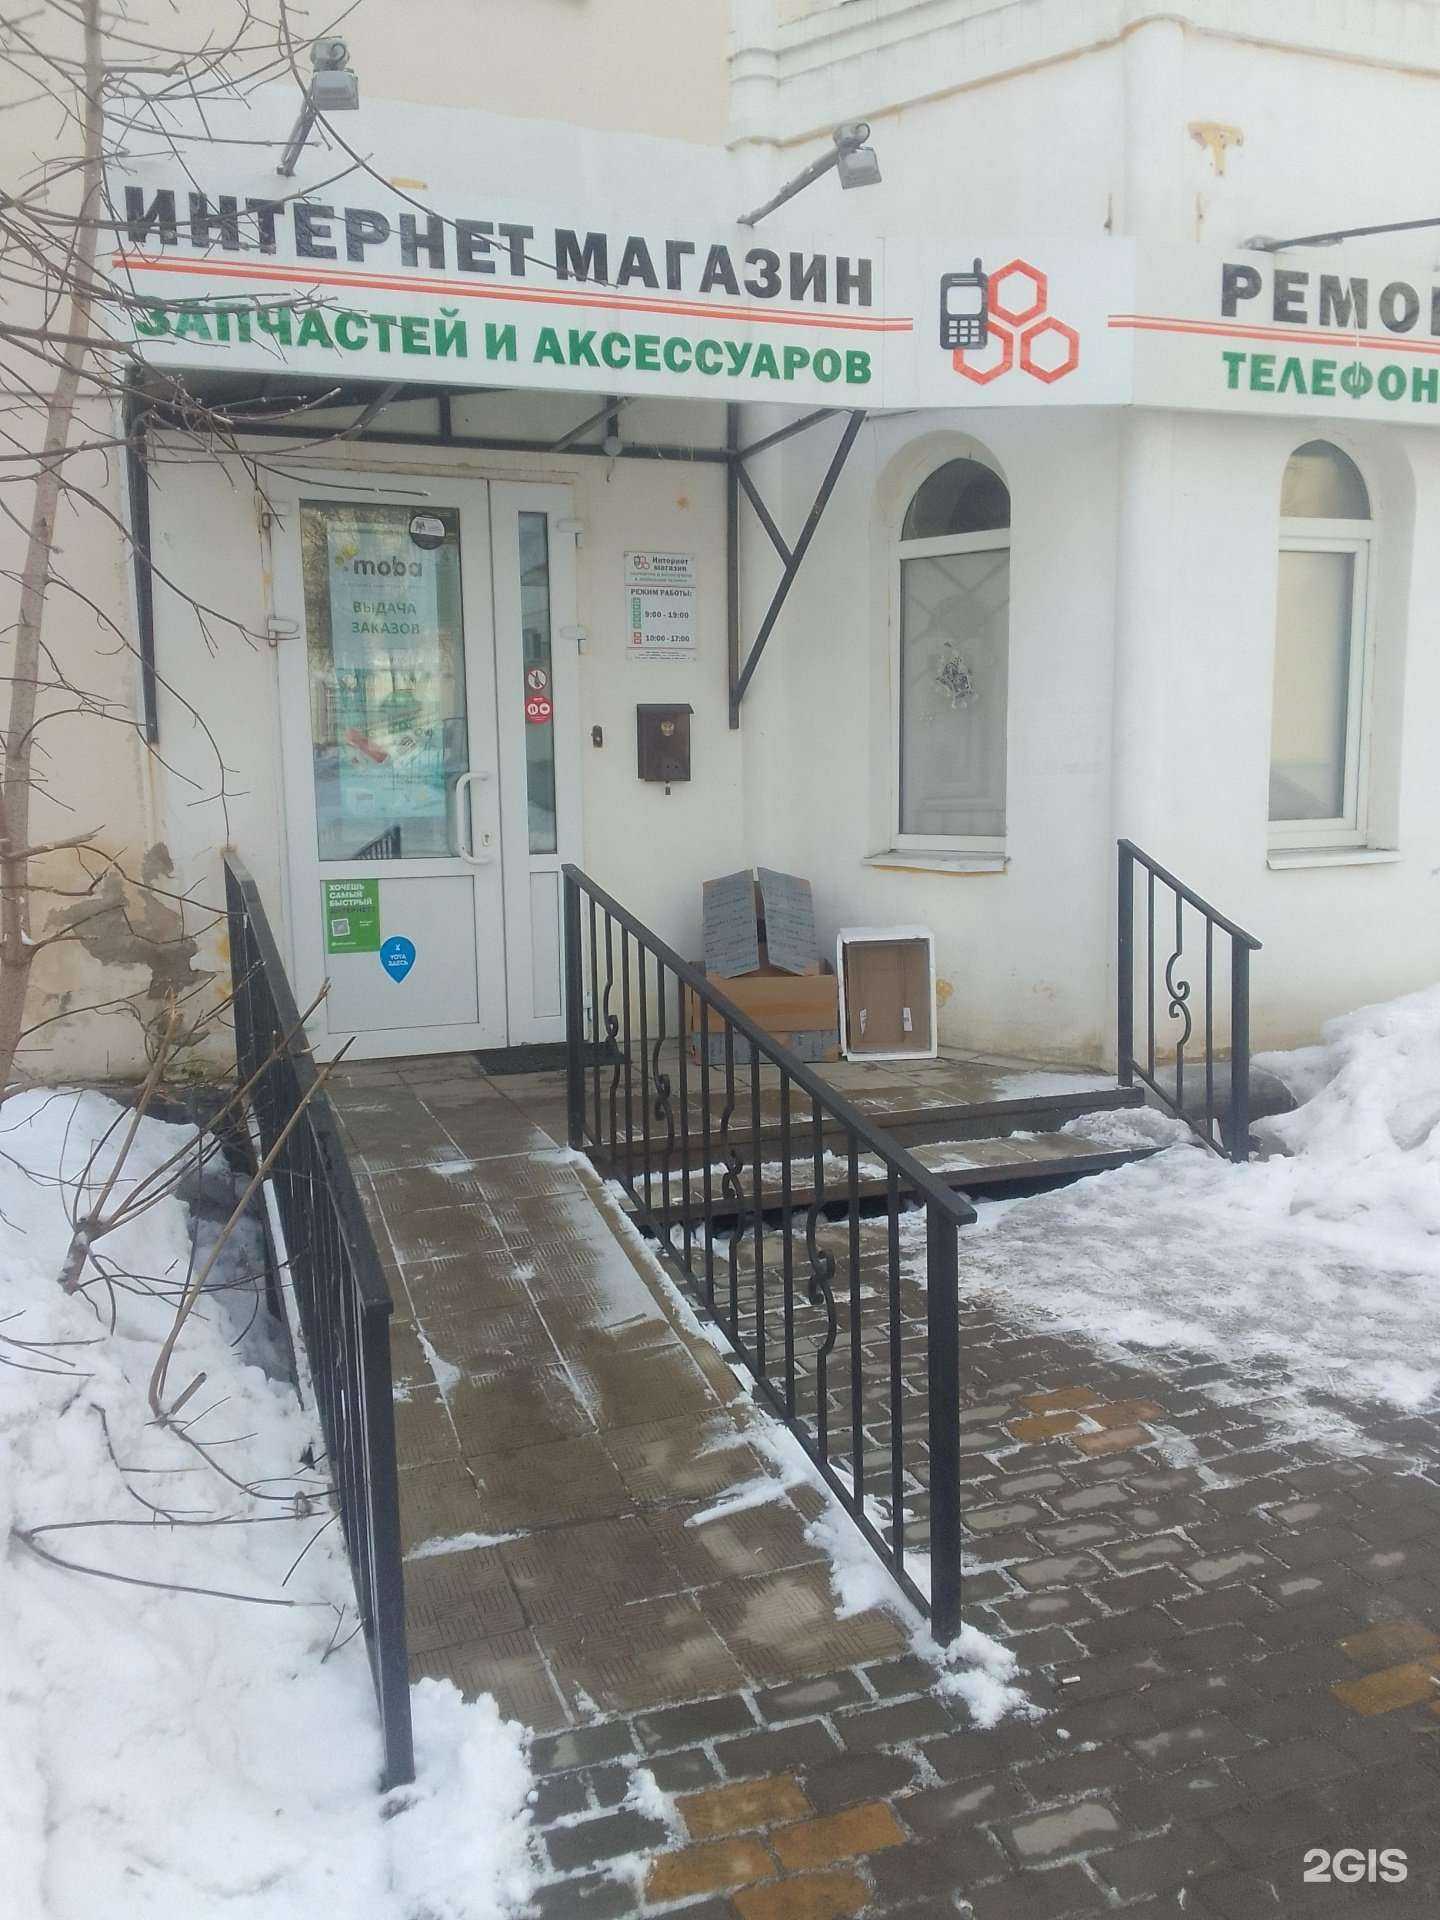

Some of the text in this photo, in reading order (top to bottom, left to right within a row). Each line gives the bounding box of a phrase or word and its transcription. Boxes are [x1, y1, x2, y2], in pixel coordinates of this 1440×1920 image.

[125, 186, 872, 306] ИНТЕРНЕТ МАГАЗИН
[136, 298, 872, 384] ЗАПЧАСТЕЙ И АКСЕССУАРОВ
[1222, 351, 1439, 404] ТЕЛЕФОН
[353, 556, 423, 577] moba
[352, 601, 417, 615] ВЫДАЧА
[351, 621, 421, 635] ЗАКАЗОВ
